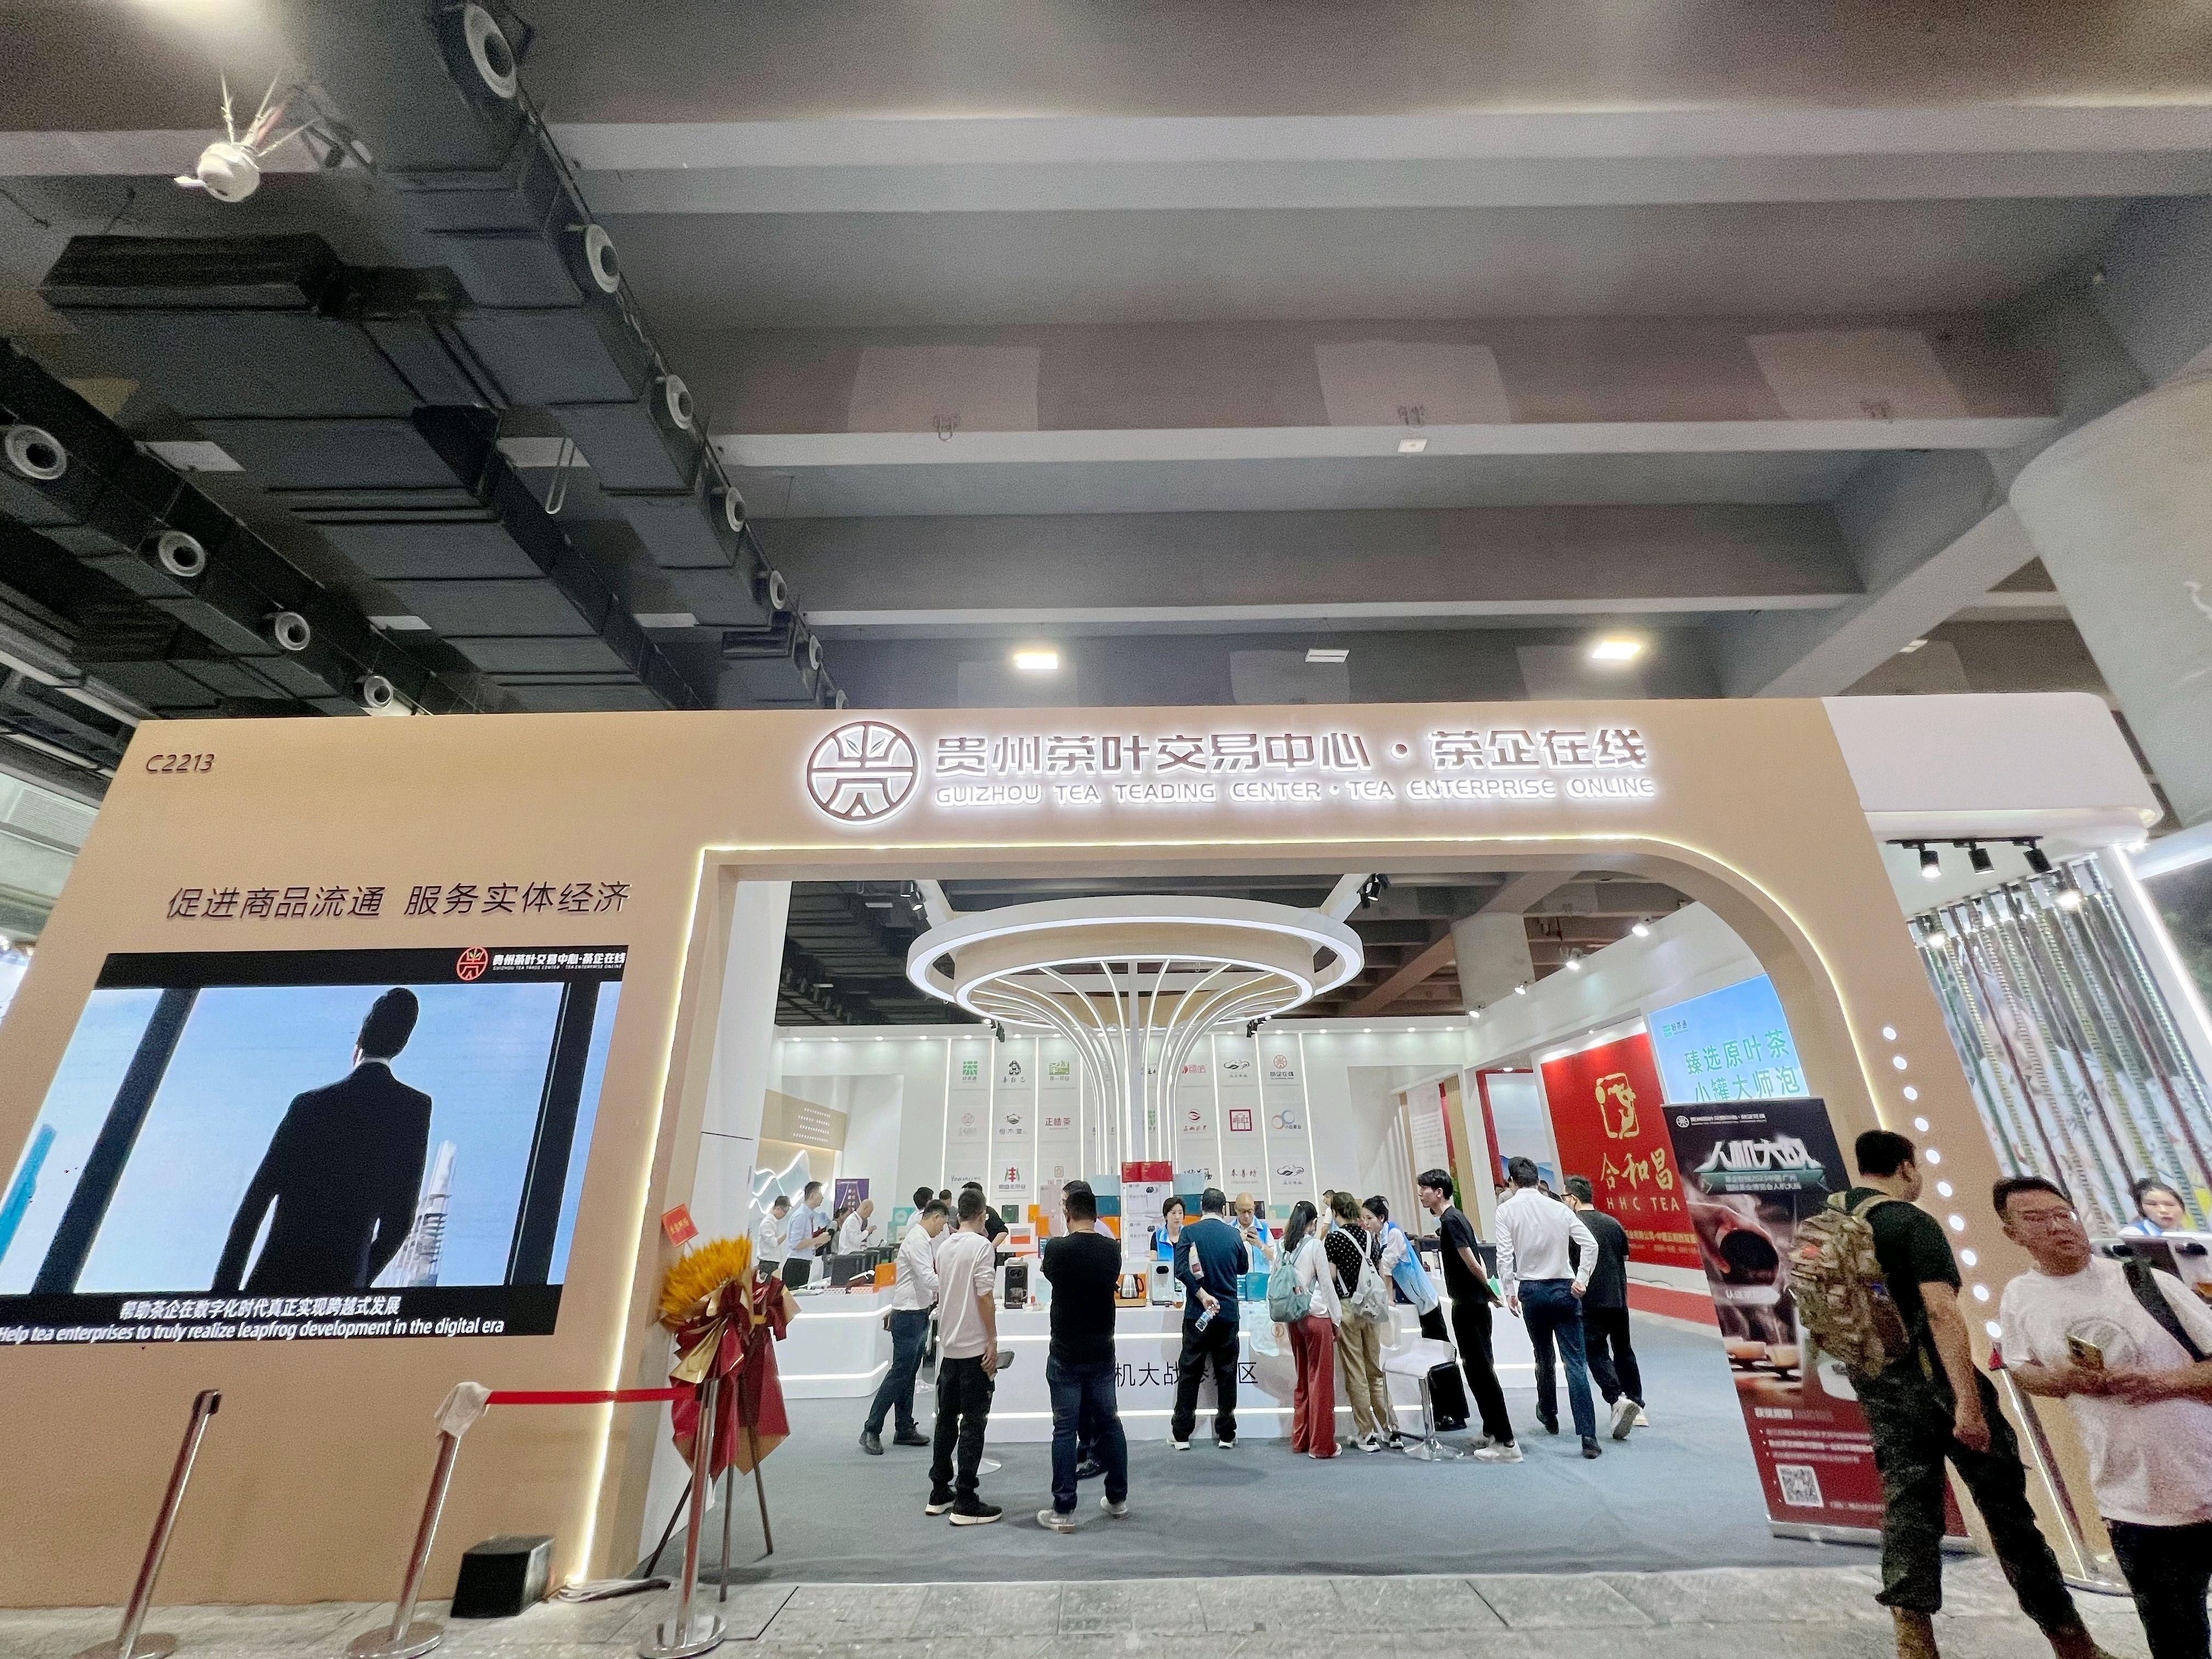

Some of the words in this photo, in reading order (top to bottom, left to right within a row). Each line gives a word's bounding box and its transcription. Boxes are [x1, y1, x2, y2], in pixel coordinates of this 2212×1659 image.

[145, 753, 215, 772] C2213
[936, 785, 1042, 805] GUIZHOU
[1054, 785, 1102, 804] TEA
[1113, 784, 1215, 804] TEADING
[1229, 782, 1321, 803] CENTER
[1346, 781, 1395, 800] TEA
[1407, 779, 1556, 799] ENTERPRISE
[1566, 778, 1654, 798] ONLINE
[166, 885, 386, 919] 促进商品流通
[403, 881, 632, 916] 服务实体经济
[1684, 1029, 1789, 1075] 臻选原叶茶
[1695, 1066, 1799, 1102] 小罐大师泡
[1600, 1147, 1673, 1190] 合和昌
[1650, 1197, 1681, 1211] TEA
[120, 1296, 402, 1319] 帮助茶企在数字化时代真正实现跨越式发展
[0, 1325, 30, 1345] Help
[31, 1327, 55, 1341] tea
[56, 1324, 136, 1344] enterprises
[136, 1324, 151, 1340] to
[154, 1323, 187, 1342] truly
[187, 1323, 235, 1339] realize
[237, 1321, 297, 1341] leapfrog
[299, 1319, 392, 1339] development
[393, 1319, 407, 1335] in
[410, 1318, 432, 1334] the
[435, 1317, 480, 1338] digital
[482, 1320, 505, 1333] era
